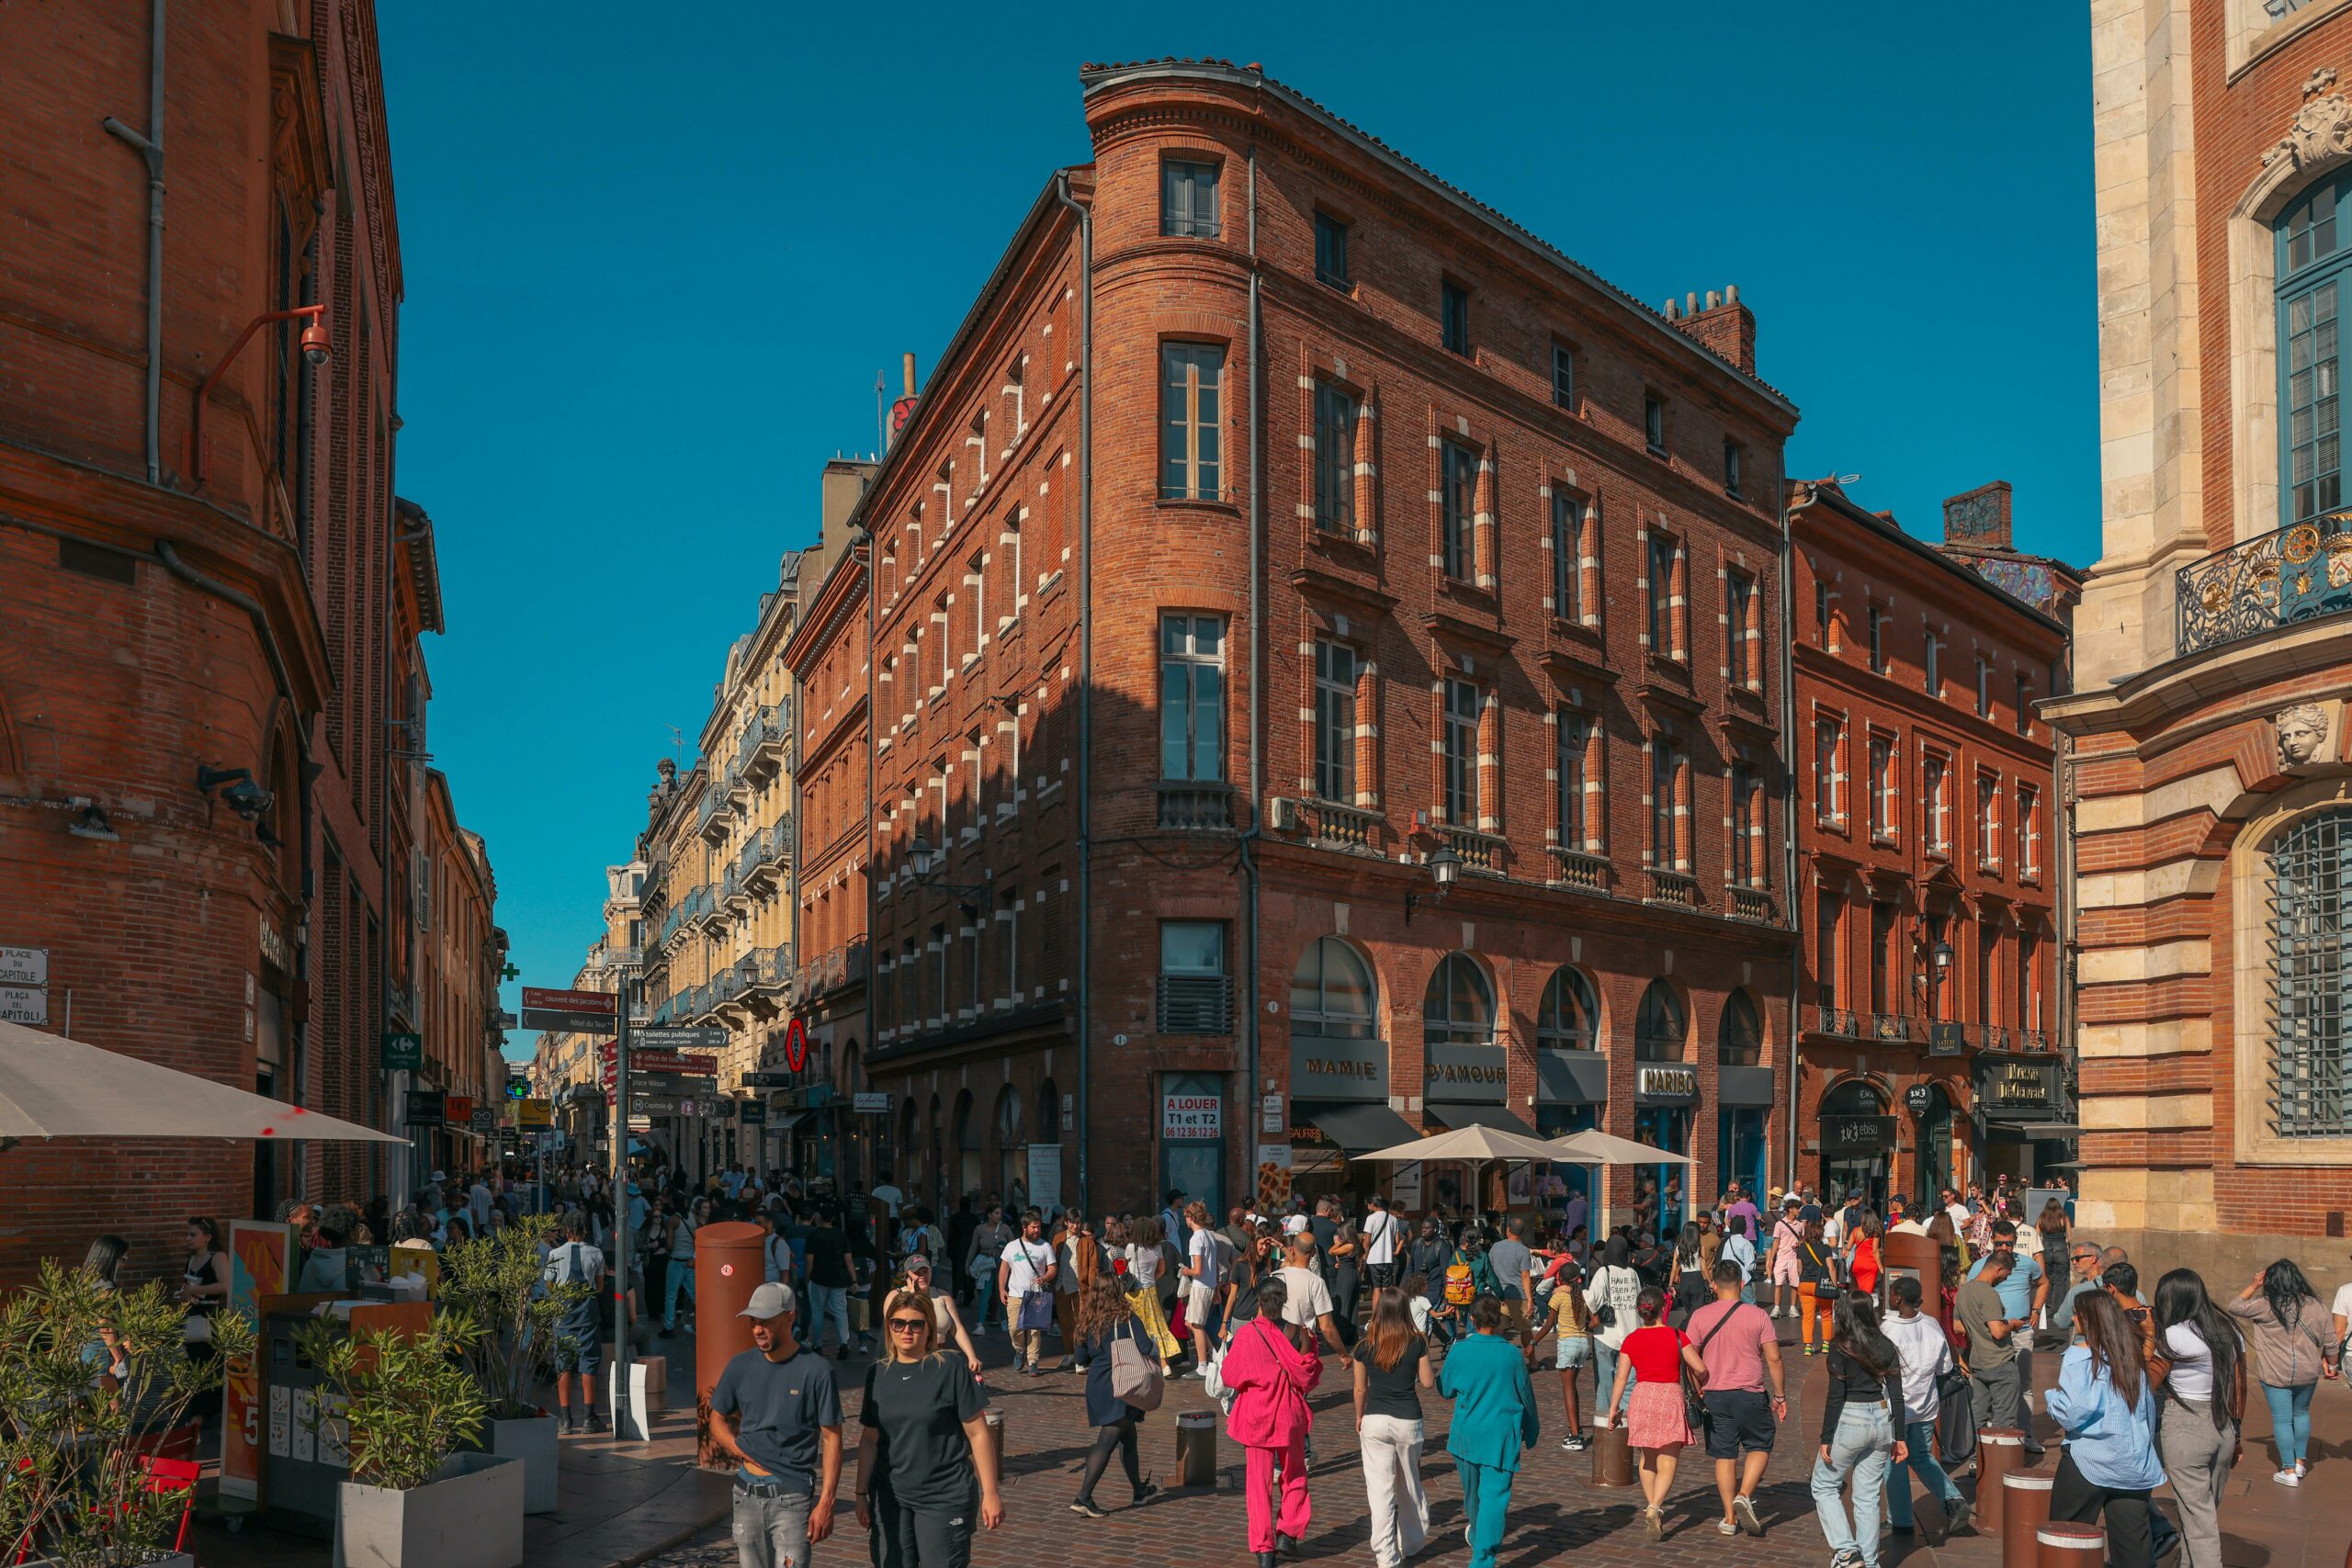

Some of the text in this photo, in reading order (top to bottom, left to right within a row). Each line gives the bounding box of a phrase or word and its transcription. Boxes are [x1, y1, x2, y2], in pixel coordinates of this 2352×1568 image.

[6, 949, 32, 959] PLACE
[5, 990, 29, 1001] PLAÇA
[545, 996, 568, 1004] couvent
[570, 1019, 585, 1027] hôtel
[671, 1031, 700, 1039] publiques
[1306, 1058, 1507, 1080] MAMIE D'AMOUR
[648, 1079, 667, 1088] Wilson
[1643, 1069, 1694, 1096] HARIBO
[644, 1102, 667, 1111] Capitole
[1167, 1098, 1218, 1110] A LOUER
[1168, 1113, 1216, 1124] T1 et T2
[1165, 1127, 1219, 1137] 06 12 36 12 26
[1289, 1128, 1321, 1139] GAUFRES
[1859, 1121, 1878, 1135] ebisu
[243, 1405, 258, 1447] 5
